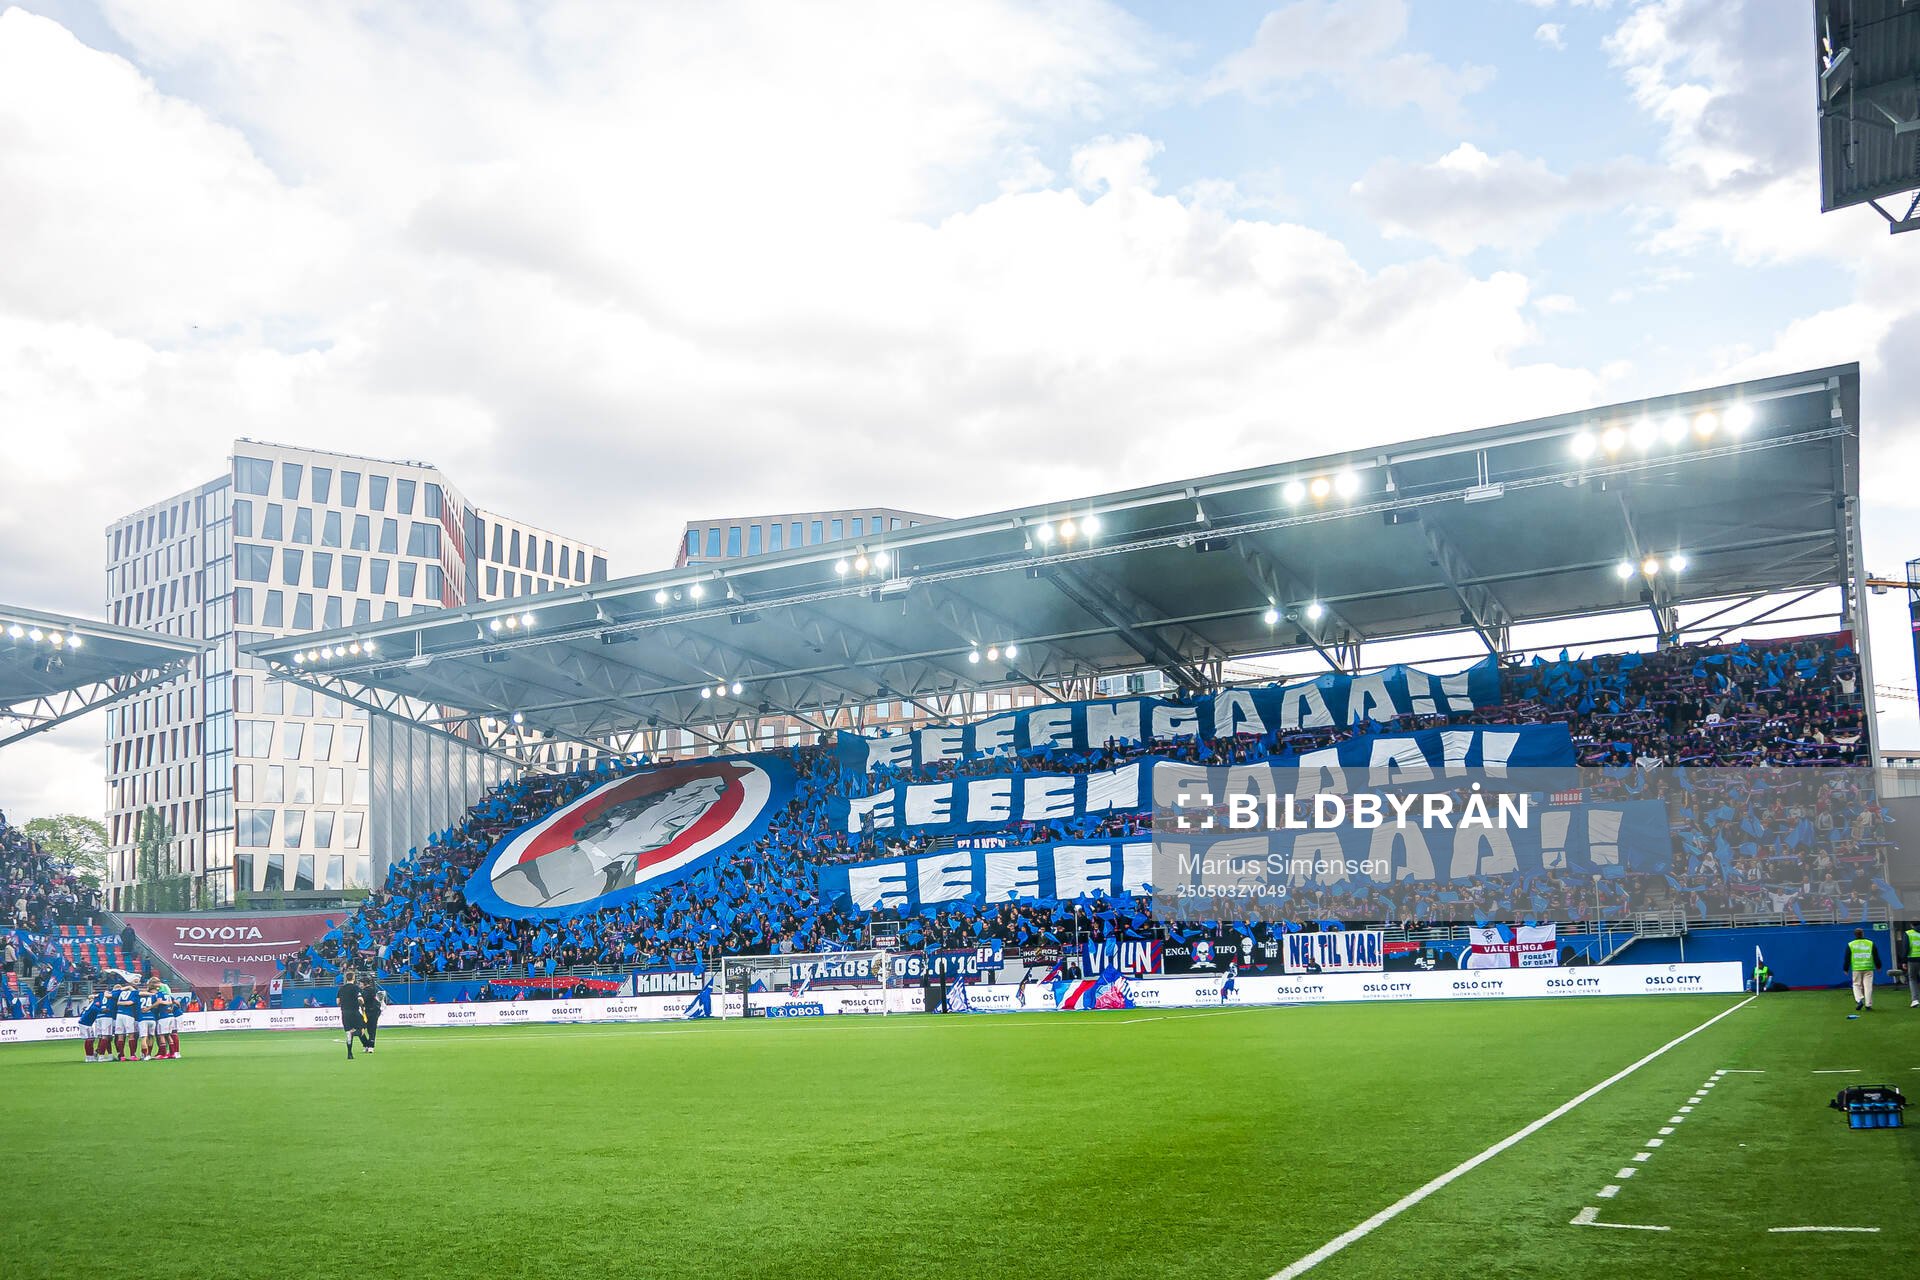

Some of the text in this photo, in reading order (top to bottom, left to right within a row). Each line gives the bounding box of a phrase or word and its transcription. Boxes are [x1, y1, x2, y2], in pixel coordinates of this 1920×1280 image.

[176, 926, 262, 940] TOYOTA
[1165, 945, 1237, 957] ENGA TIFO
[1289, 935, 1315, 967] NEI
[1318, 934, 1341, 968] TIL
[1345, 932, 1383, 967] VAR!
[1484, 943, 1544, 953] VALERENGA
[172, 953, 234, 963] MATERIAL
[1523, 952, 1552, 961] FOREST
[1535, 958, 1554, 966] DEAN
[637, 972, 702, 993] KOKOS
[1547, 978, 1600, 987] OSLO CITY
[1645, 975, 1701, 985] OSLO CITY
[1196, 989, 1218, 997] OSLO
[1363, 984, 1388, 992] OSLO
[1043, 993, 1054, 1001] OS
[1141, 990, 1160, 998] CITY
[140, 997, 152, 1009] 24
[789, 1006, 821, 1016] OBOS
